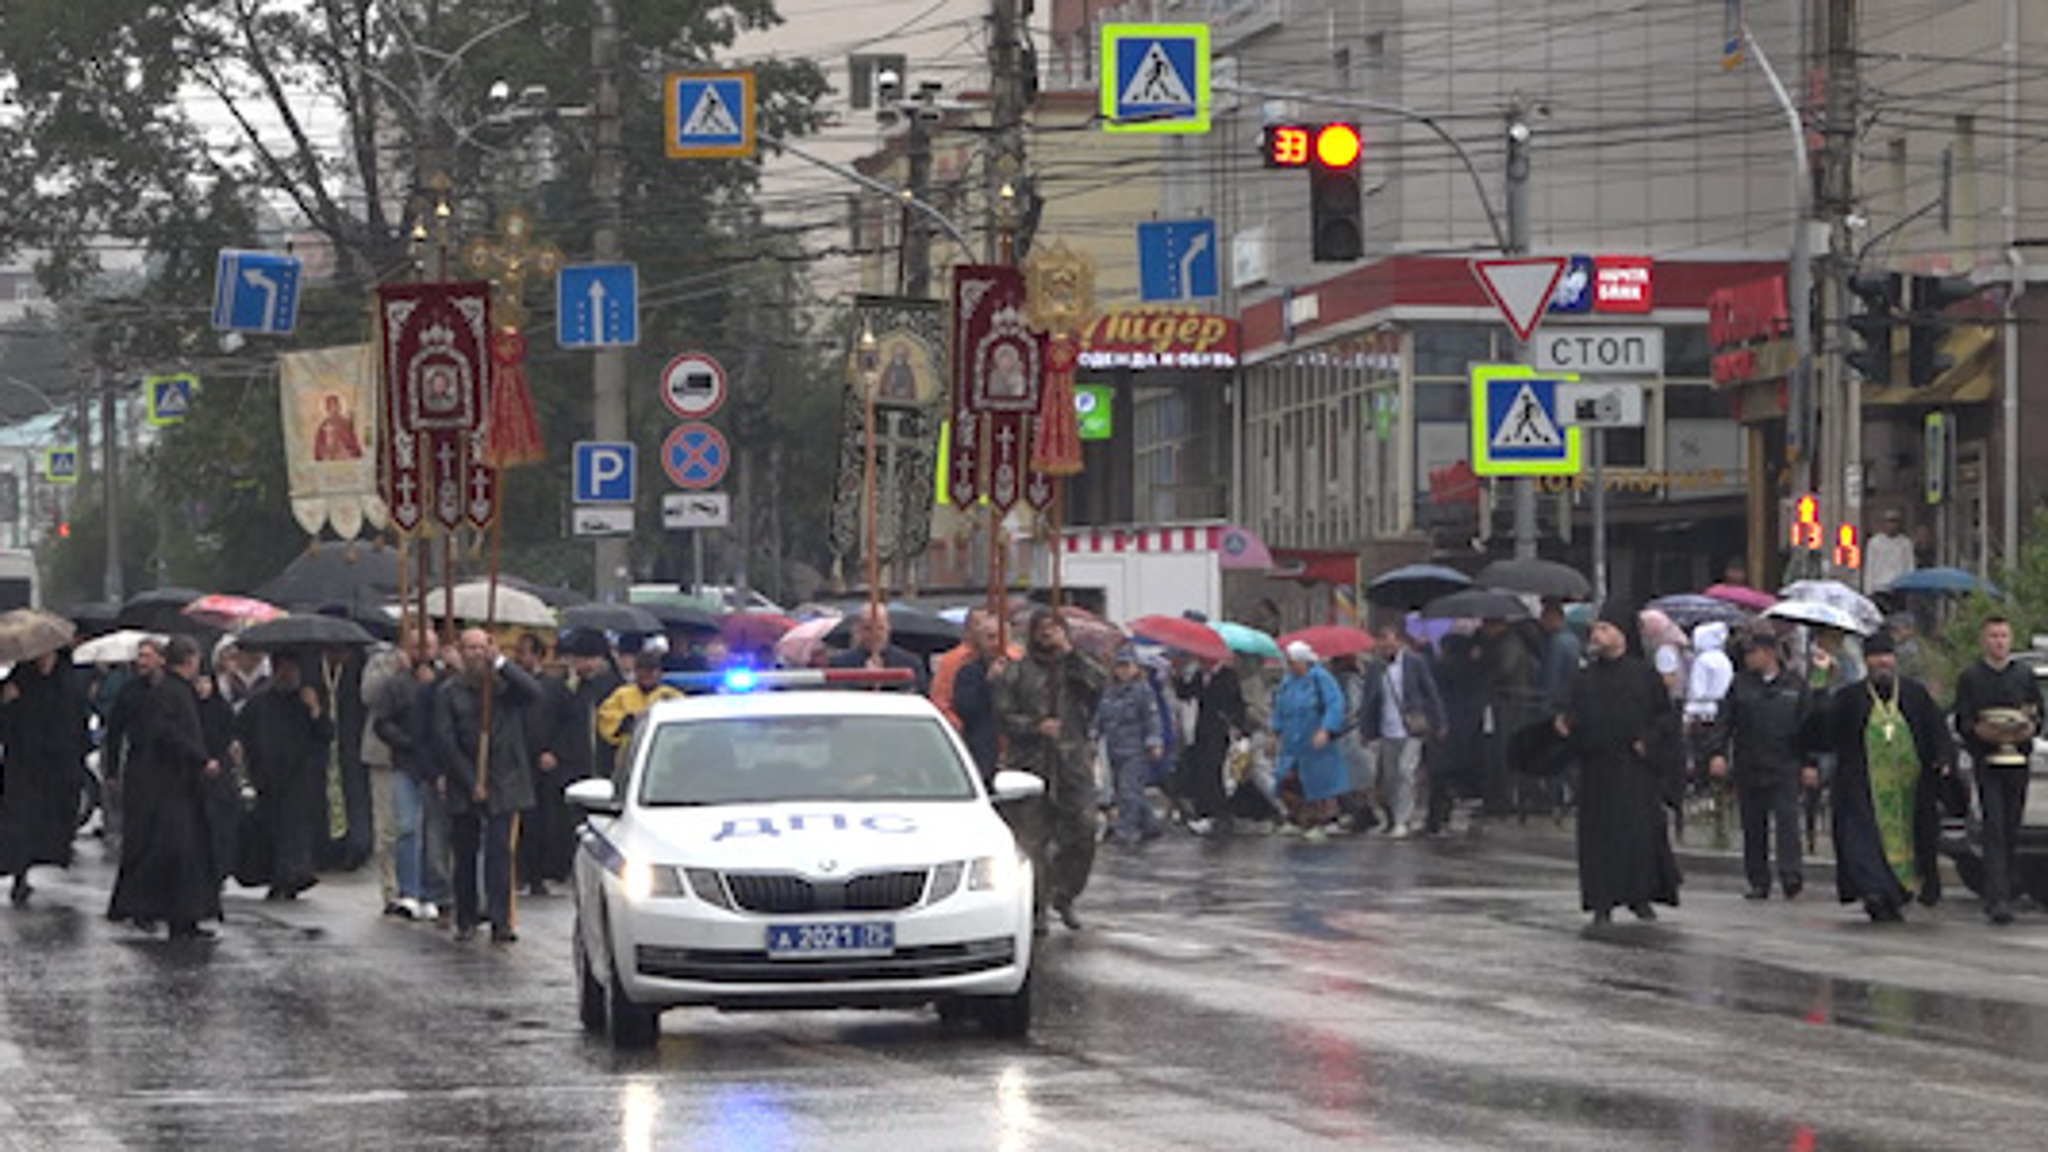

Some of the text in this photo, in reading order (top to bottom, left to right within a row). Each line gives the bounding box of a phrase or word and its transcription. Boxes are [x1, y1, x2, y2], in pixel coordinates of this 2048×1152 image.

[1274, 127, 1309, 163] 33
[1551, 336, 1646, 366] СТОП
[711, 813, 918, 842] ДПС
